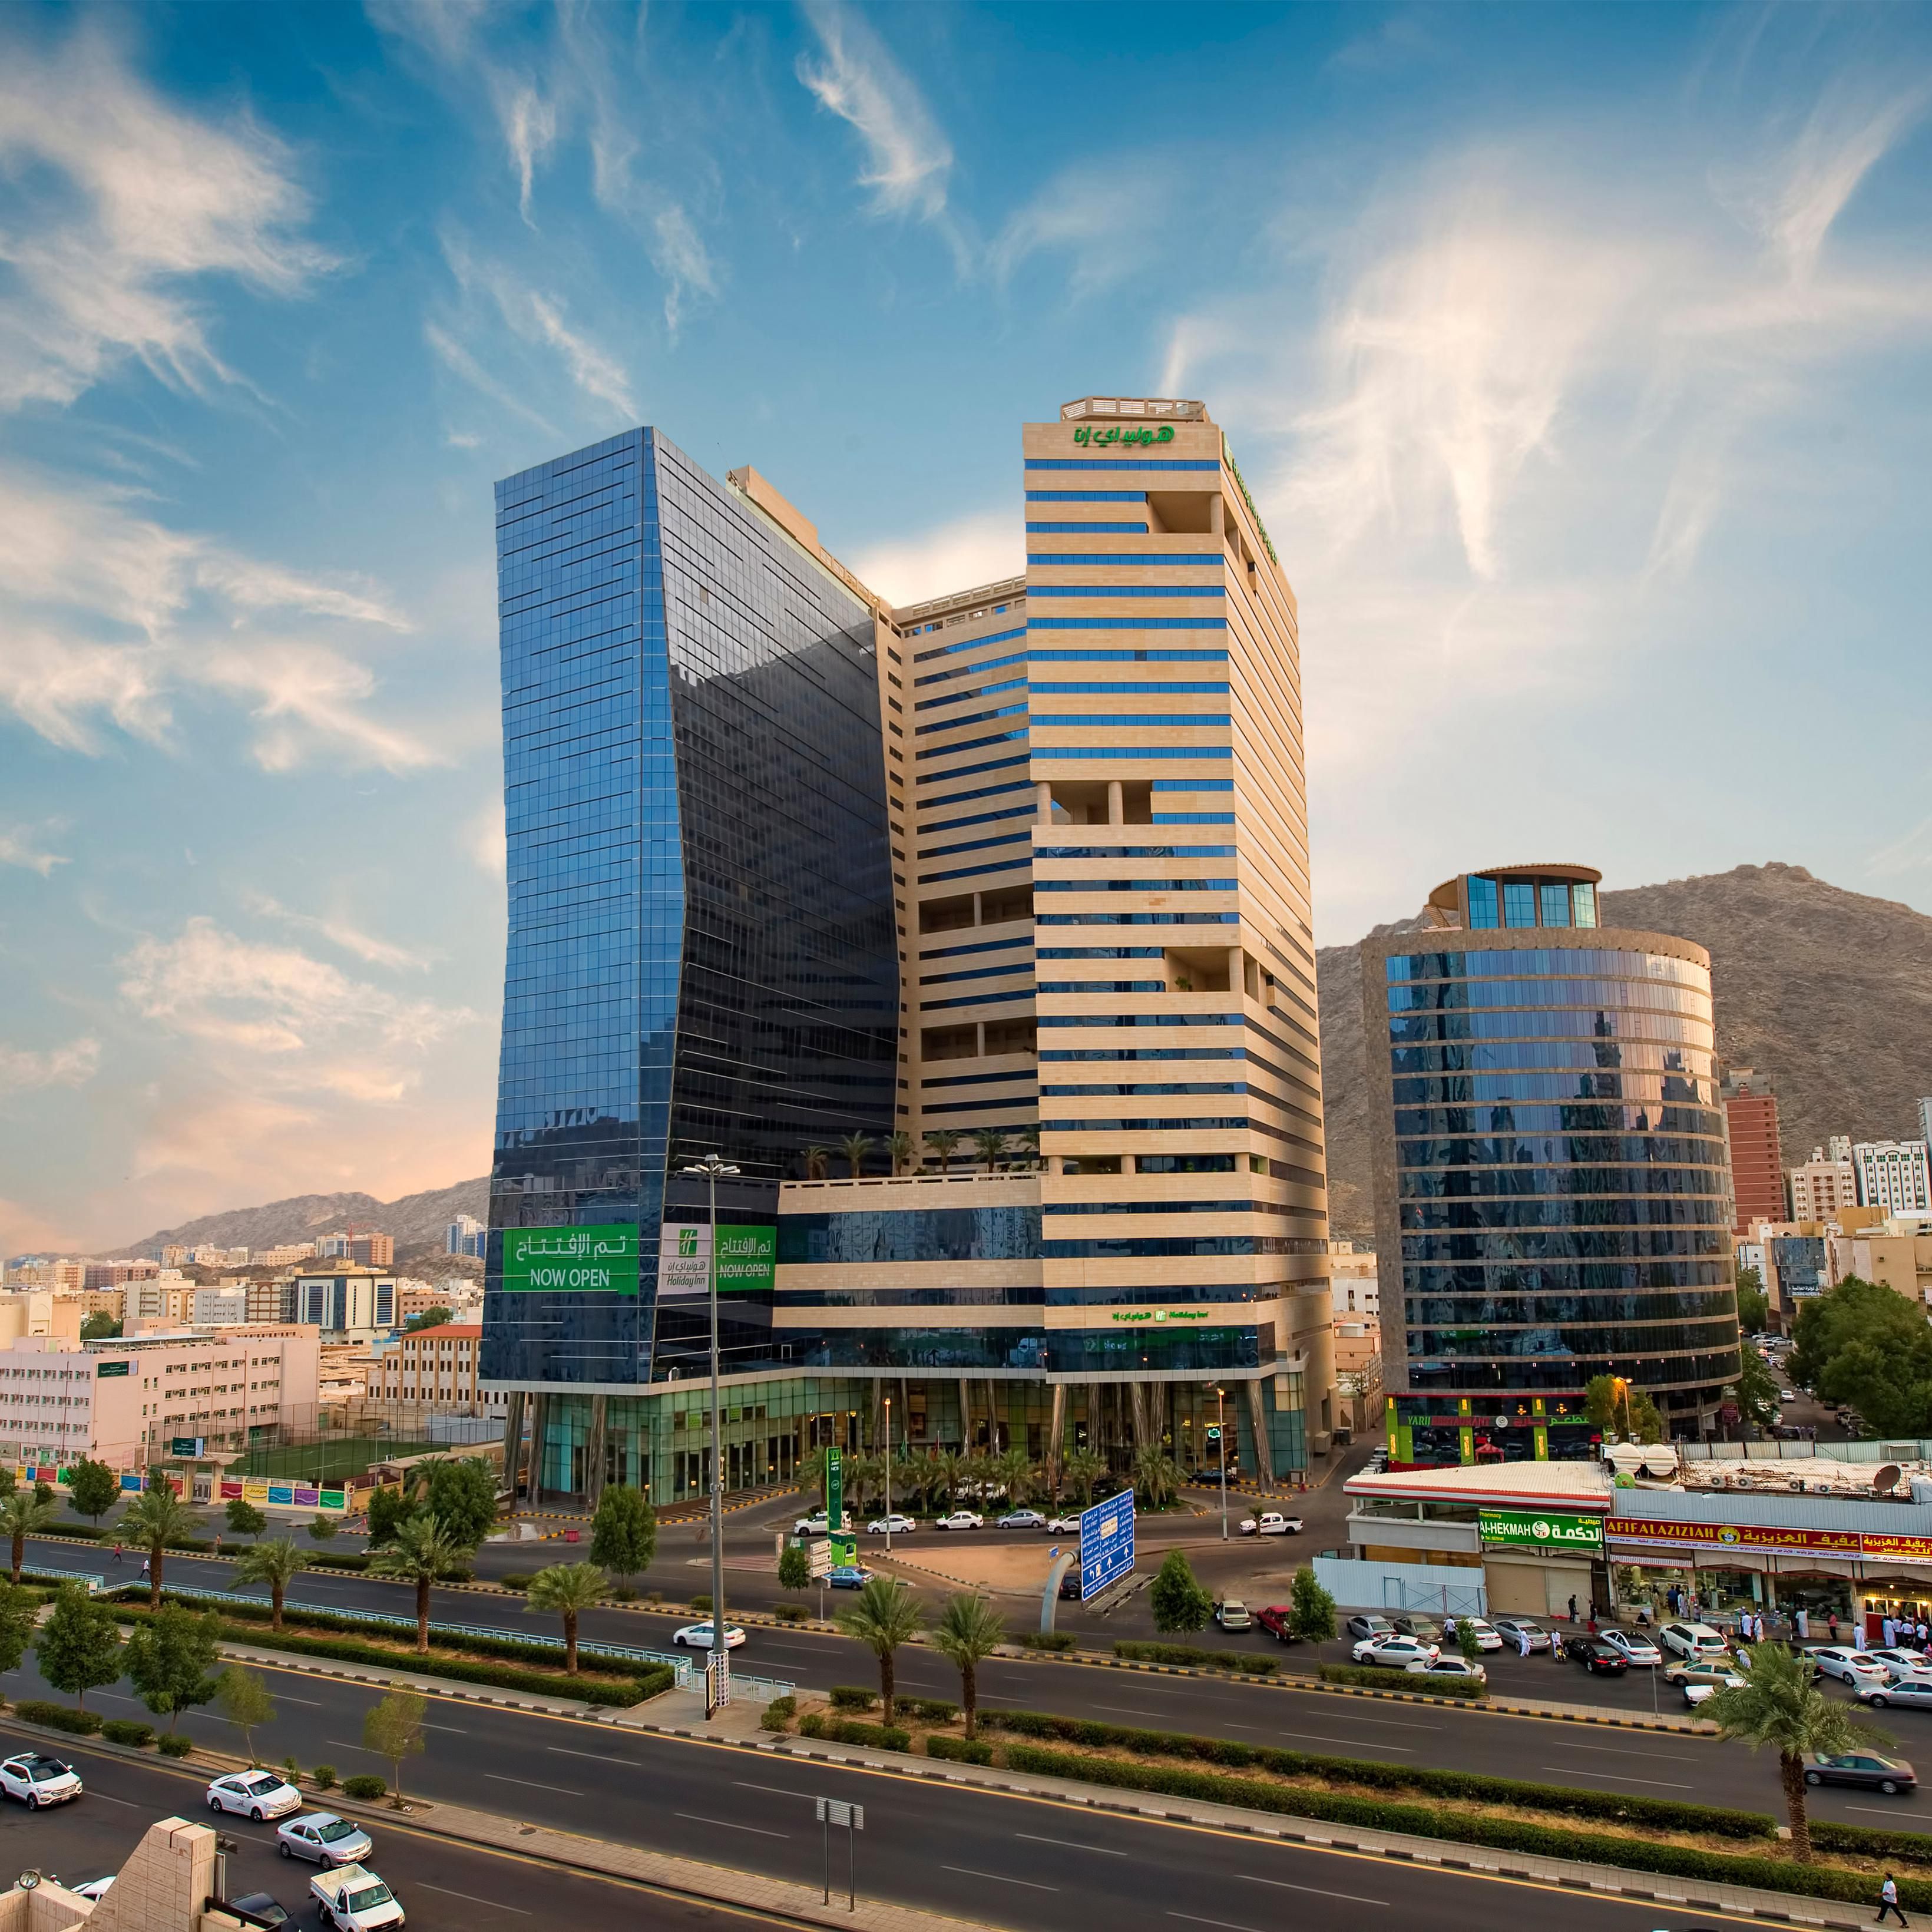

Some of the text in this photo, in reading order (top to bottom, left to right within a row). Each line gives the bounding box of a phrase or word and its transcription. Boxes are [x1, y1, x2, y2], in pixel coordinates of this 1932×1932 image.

[594, 1235, 626, 1261] تم
[757, 1239, 770, 1258] تم
[530, 1268, 610, 1287] NOW OPEN
[719, 1263, 770, 1278] NOW OPEN
[667, 1274, 705, 1288] Holiday Inn
[1169, 1311, 1196, 1320] Holiday
[1552, 1524, 1603, 1542] الحكمة
[1744, 1530, 1807, 1544] العزيزية
[1812, 1534, 1859, 1548] عفيف
[1864, 1536, 1899, 1547] العزيزية
